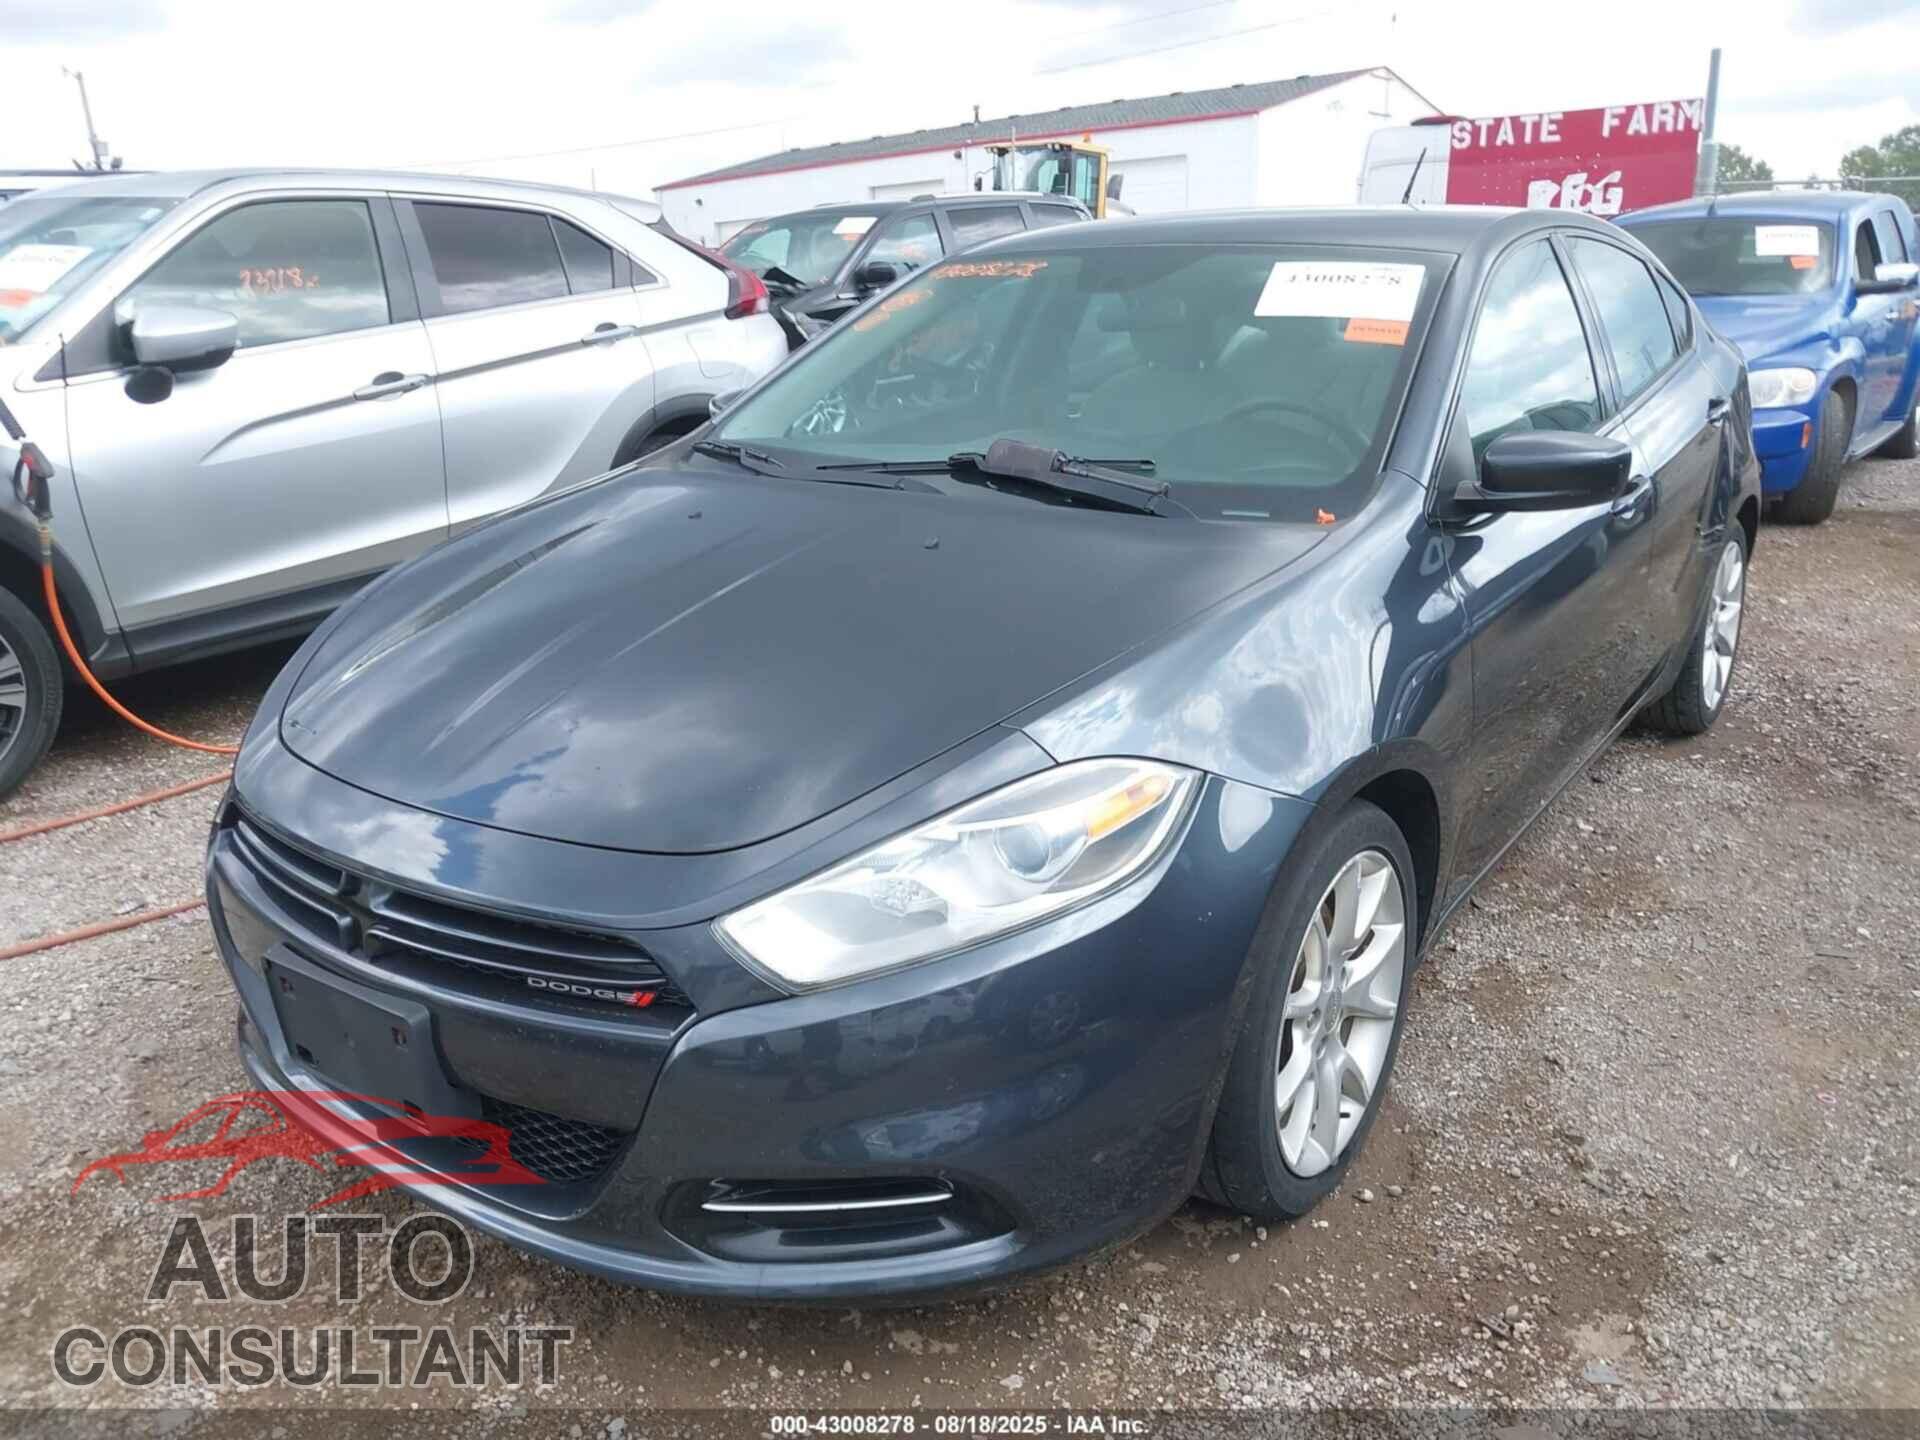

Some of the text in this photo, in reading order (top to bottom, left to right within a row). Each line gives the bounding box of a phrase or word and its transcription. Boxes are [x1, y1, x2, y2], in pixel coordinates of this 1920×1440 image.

[1451, 99, 1703, 150] STATE FARM
[527, 976, 638, 1005] DODGE
